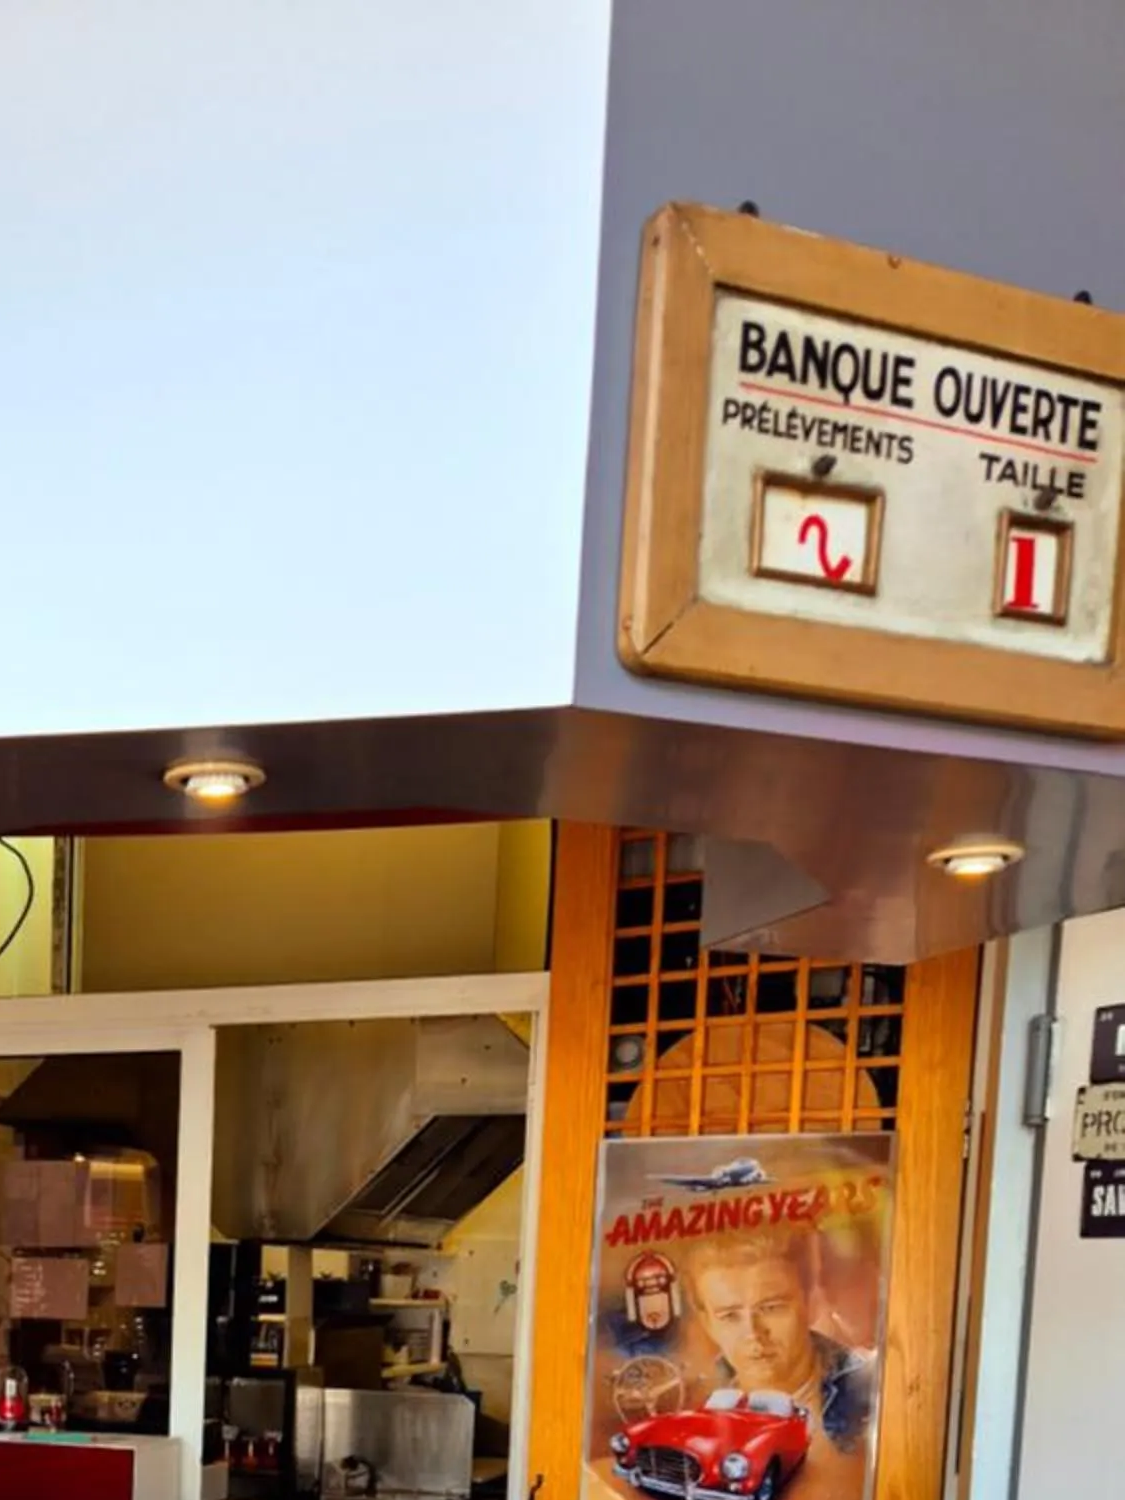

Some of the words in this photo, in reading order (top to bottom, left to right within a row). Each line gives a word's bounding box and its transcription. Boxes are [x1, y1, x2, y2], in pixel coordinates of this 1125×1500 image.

[738, 320, 916, 408] BANQUE
[933, 366, 1102, 452] OUVERTE
[978, 451, 1088, 499] TAILLE
[605, 1196, 765, 1247] AMAZING
